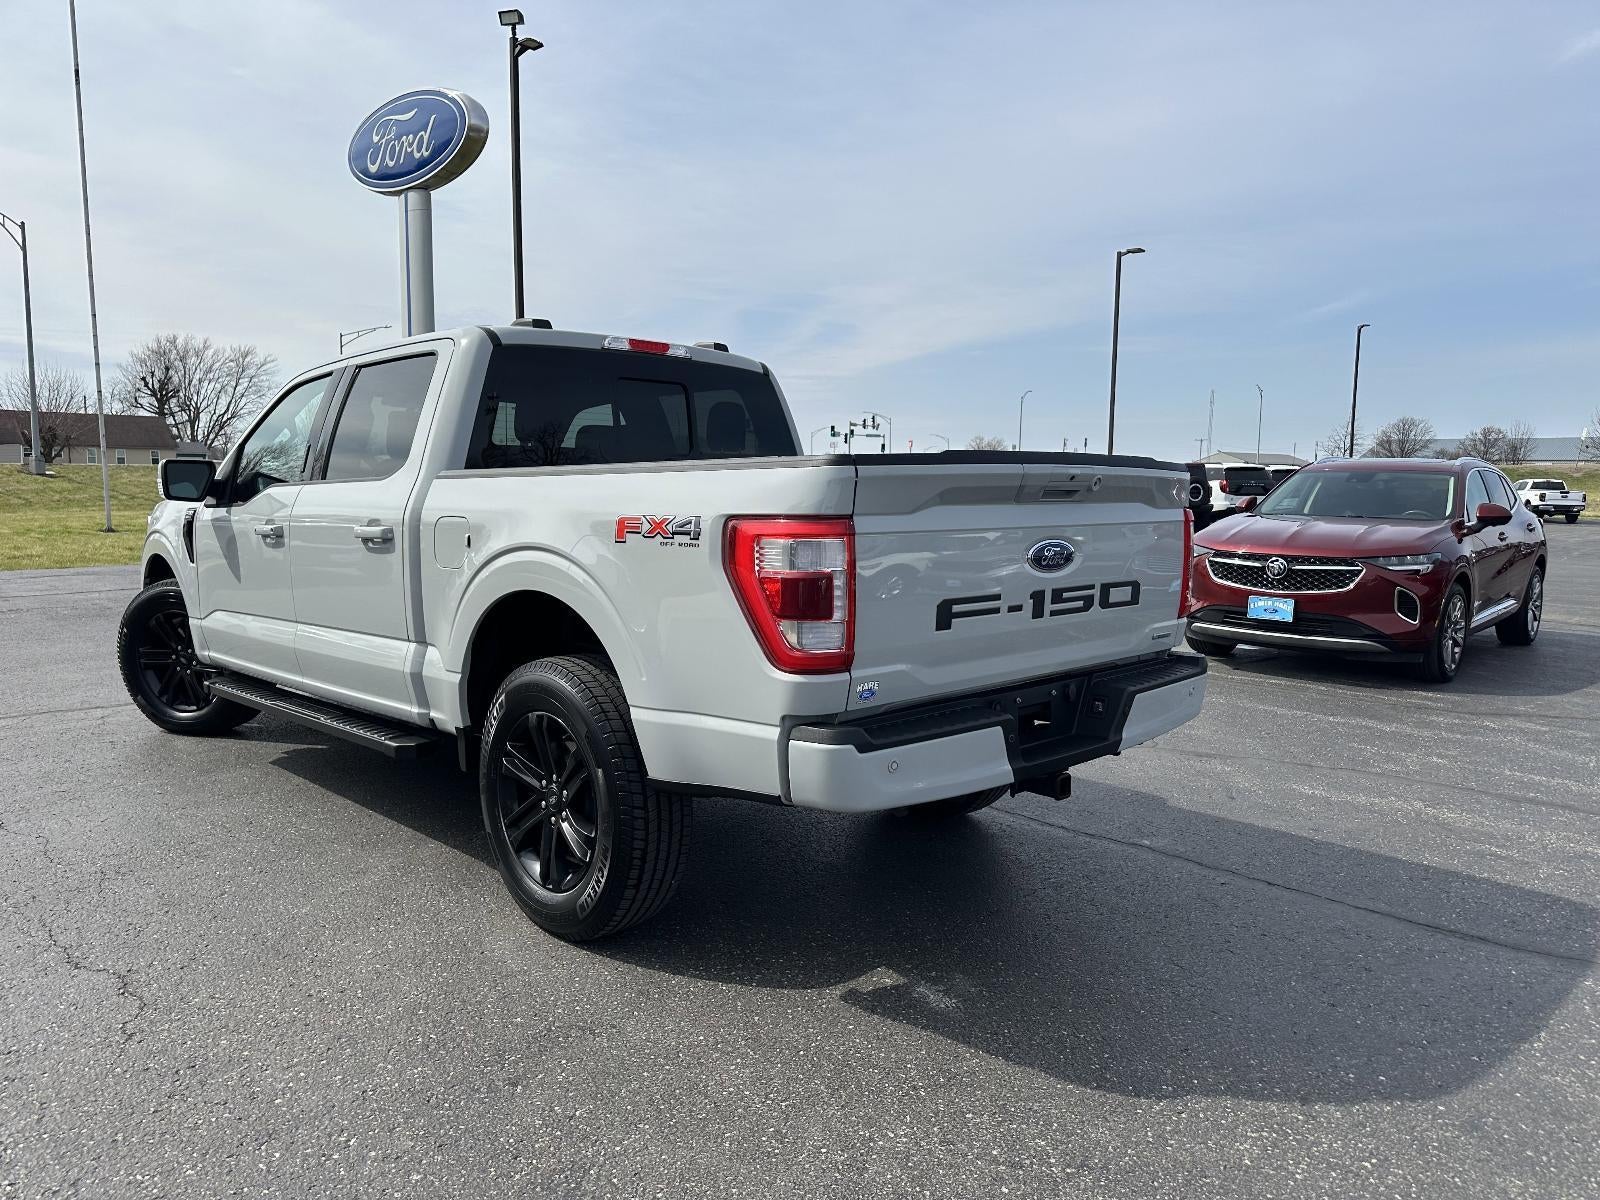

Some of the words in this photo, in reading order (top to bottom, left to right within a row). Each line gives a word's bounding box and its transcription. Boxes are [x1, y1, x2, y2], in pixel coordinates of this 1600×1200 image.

[368, 108, 436, 173] Ford
[615, 515, 702, 543] FX4
[1041, 546, 1068, 565] Ford
[935, 579, 1141, 632] F-150
[857, 681, 879, 692] HARE
